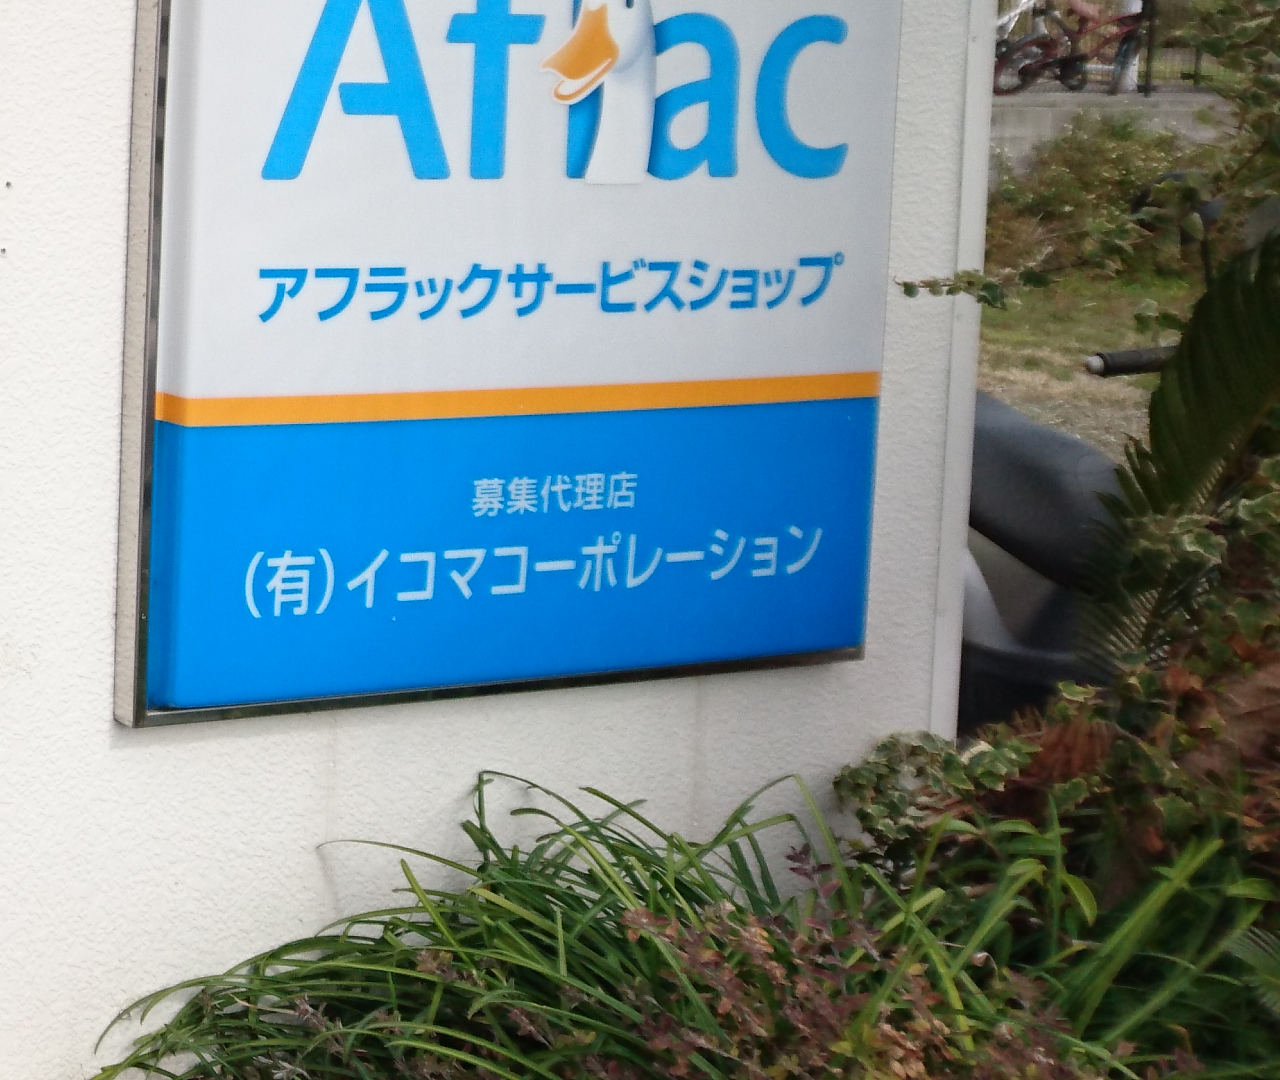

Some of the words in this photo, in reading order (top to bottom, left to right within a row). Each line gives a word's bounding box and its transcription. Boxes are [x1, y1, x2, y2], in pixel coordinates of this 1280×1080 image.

[258, 252, 845, 323] アフラックサービスショップ
[471, 471, 639, 518] 募集代理店
[244, 526, 822, 618] (有)イコマコーポレーション
